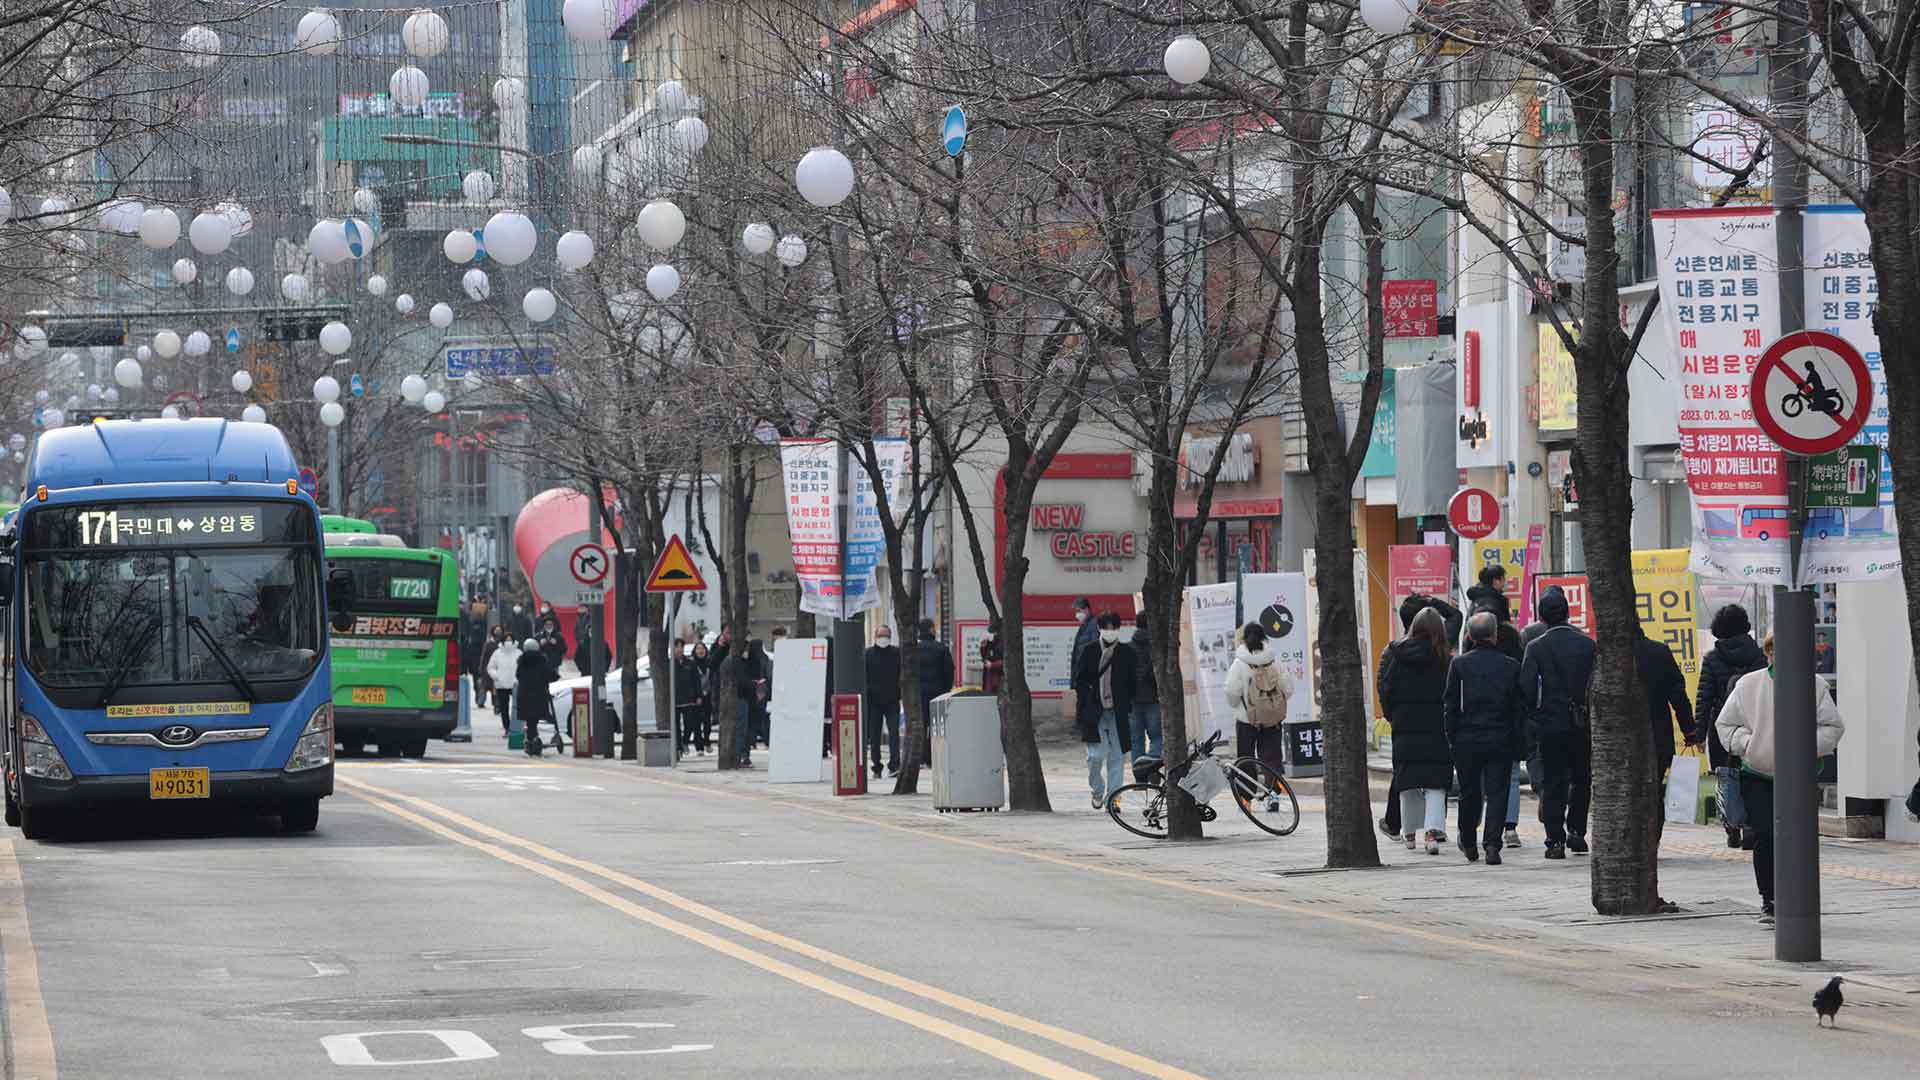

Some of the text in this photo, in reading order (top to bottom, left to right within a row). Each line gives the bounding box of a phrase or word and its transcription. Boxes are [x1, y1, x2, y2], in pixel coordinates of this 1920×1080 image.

[1674, 255, 1758, 272] 신촌연세로
[1676, 278, 1759, 298] 대중교통
[1678, 304, 1760, 323] 전용지구
[1680, 329, 1761, 348] 해 제
[1714, 457, 1777, 475] 재개됩니다!
[1032, 504, 1084, 531] NEW
[78, 511, 256, 545] 171 국민대 상암동
[1051, 530, 1137, 560] CASTLE
[391, 579, 430, 598] 7720
[182, 770, 195, 778] 70
[154, 779, 204, 795] 사9031
